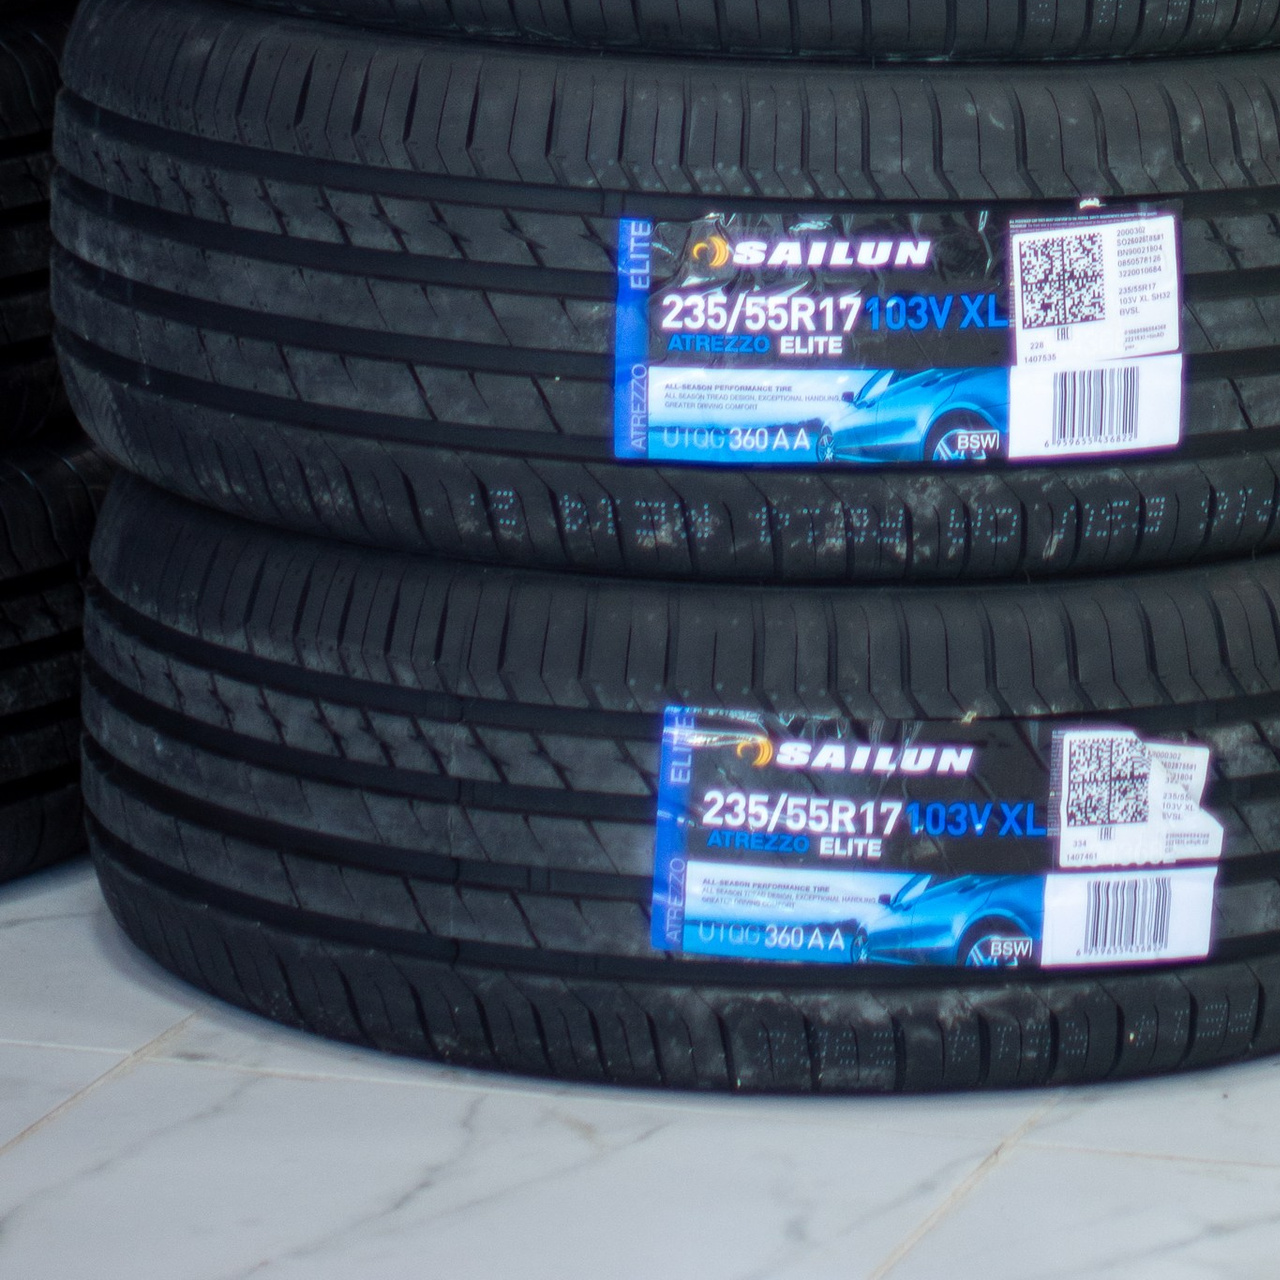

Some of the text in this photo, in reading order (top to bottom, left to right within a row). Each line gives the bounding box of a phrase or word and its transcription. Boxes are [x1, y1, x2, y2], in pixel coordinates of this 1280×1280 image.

[1117, 226, 1146, 237] 2000302
[630, 220, 651, 290] ELITE
[732, 240, 931, 265] SAILUN
[1117, 244, 1163, 257] BN90021804
[1118, 265, 1162, 278] 3220010684
[1119, 296, 1138, 305] 103V
[1151, 291, 1171, 301] SH32
[661, 293, 1009, 333] 235/55R17 103V XL
[1119, 307, 1140, 316] BVSL
[668, 333, 843, 354] ATREZZO ELITE
[1029, 341, 1044, 350] 228
[664, 383, 713, 391] ALL-SEASON
[714, 384, 773, 392] PERFORMANCE
[631, 363, 648, 451] ATREZZO
[729, 426, 769, 451] 360
[957, 433, 997, 450] BSW
[776, 742, 974, 773] SAILUN
[702, 790, 1048, 837] 235/55R17 103V XL
[706, 830, 883, 858] ATREZZO ELITE
[666, 857, 686, 943] ATREZZO
[764, 923, 804, 949] 360
[990, 941, 1030, 958] BSW
